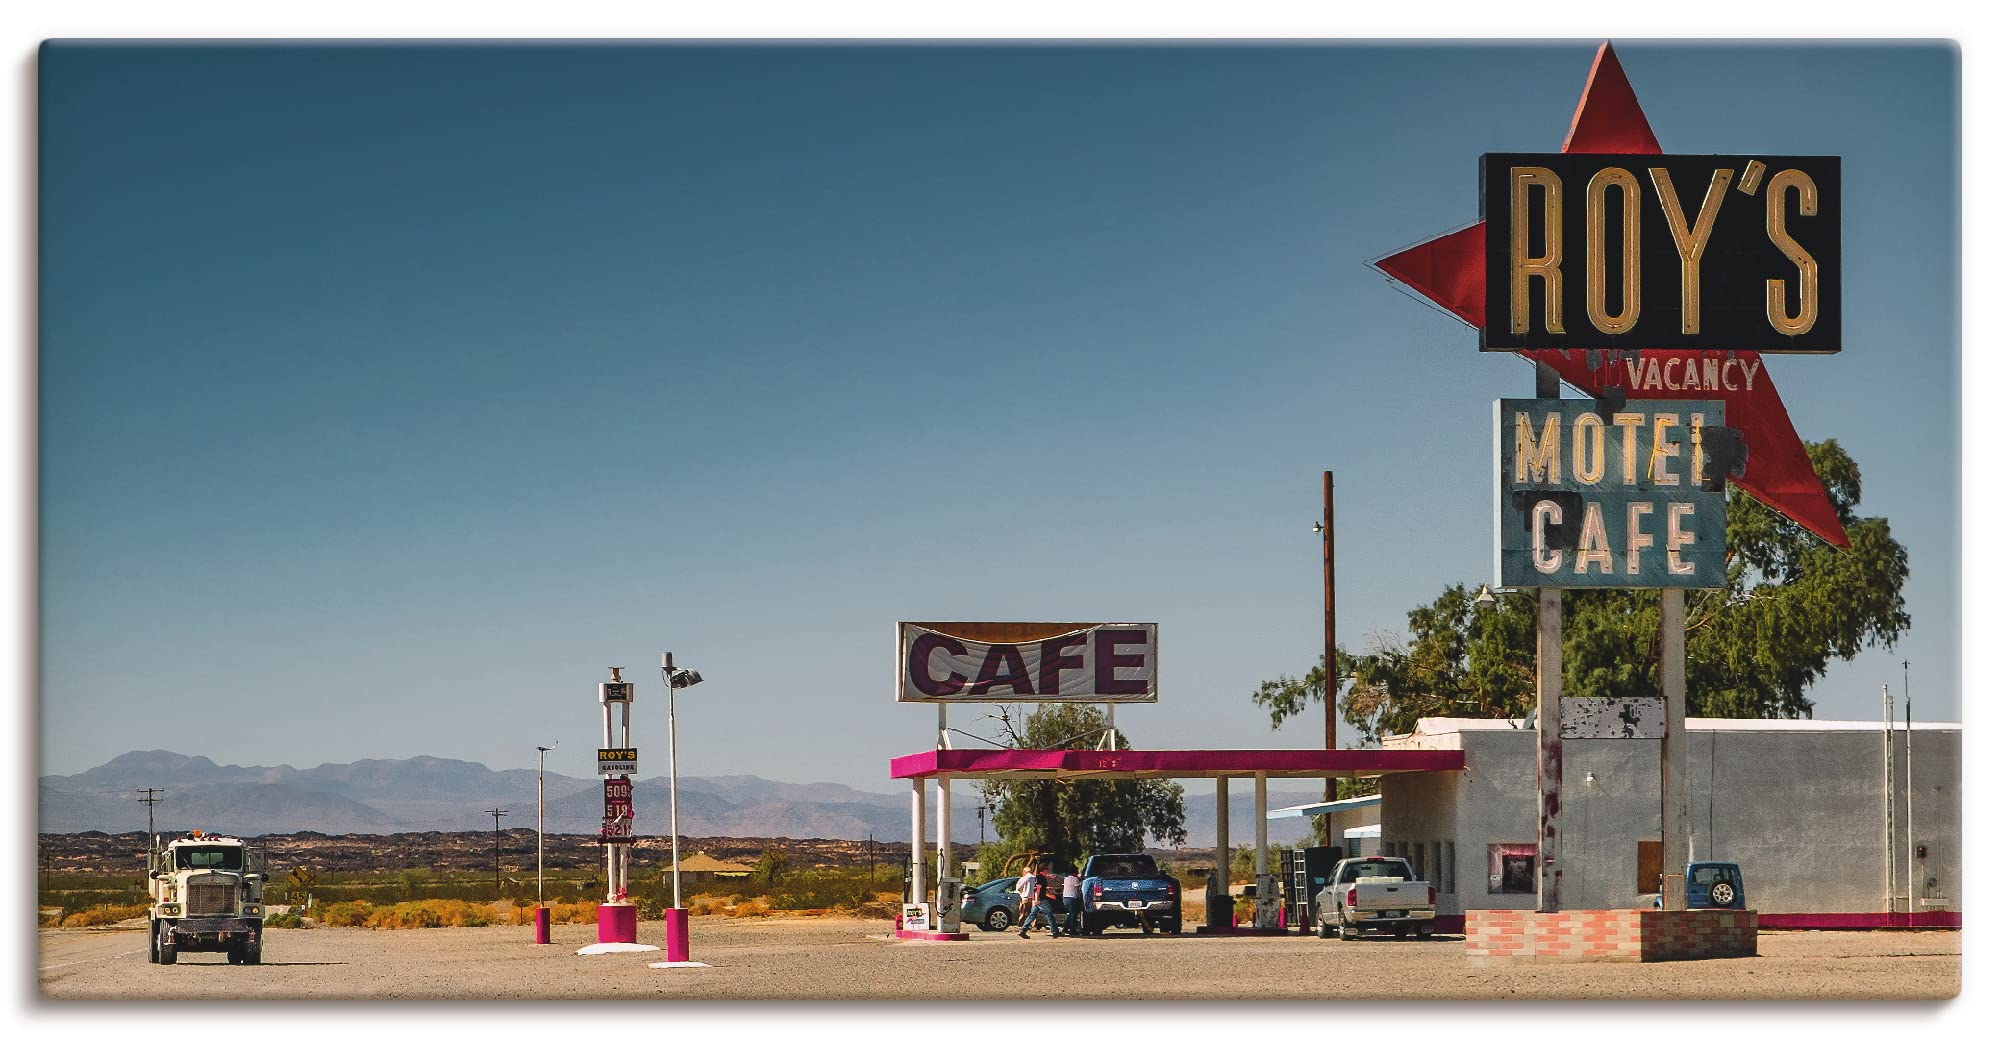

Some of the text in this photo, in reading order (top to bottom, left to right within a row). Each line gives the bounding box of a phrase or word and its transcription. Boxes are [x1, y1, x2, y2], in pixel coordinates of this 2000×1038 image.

[1511, 159, 1818, 335] ROY'S
[1625, 357, 1761, 391] VACANCY
[1515, 411, 1711, 486] MOTEL
[1531, 499, 1695, 574] CAFE
[908, 629, 1149, 697] CAFE
[600, 751, 636, 760] ROY'S
